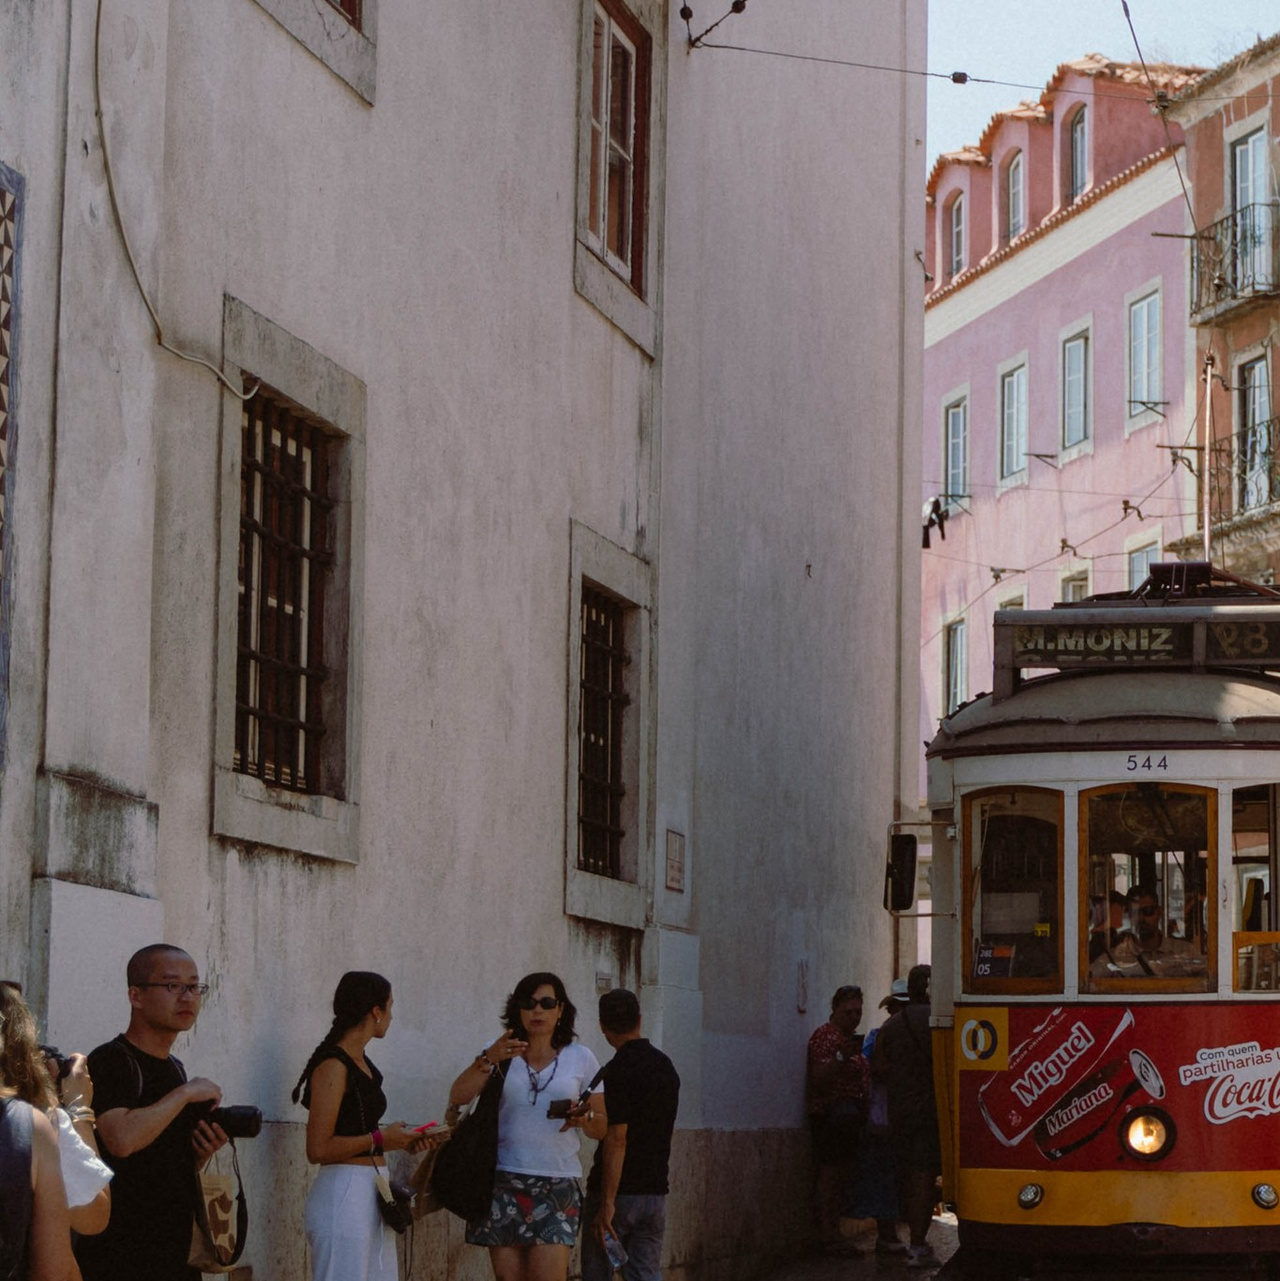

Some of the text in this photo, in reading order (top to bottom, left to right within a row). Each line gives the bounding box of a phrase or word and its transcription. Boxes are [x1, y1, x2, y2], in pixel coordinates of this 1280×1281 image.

[1127, 754, 1169, 771] 544
[977, 964, 991, 975] 05
[1199, 1043, 1258, 1061] Com quem
[1011, 1022, 1095, 1107] Miguel
[1182, 1052, 1273, 1081] partilharias
[1045, 1083, 1114, 1136] Mariana
